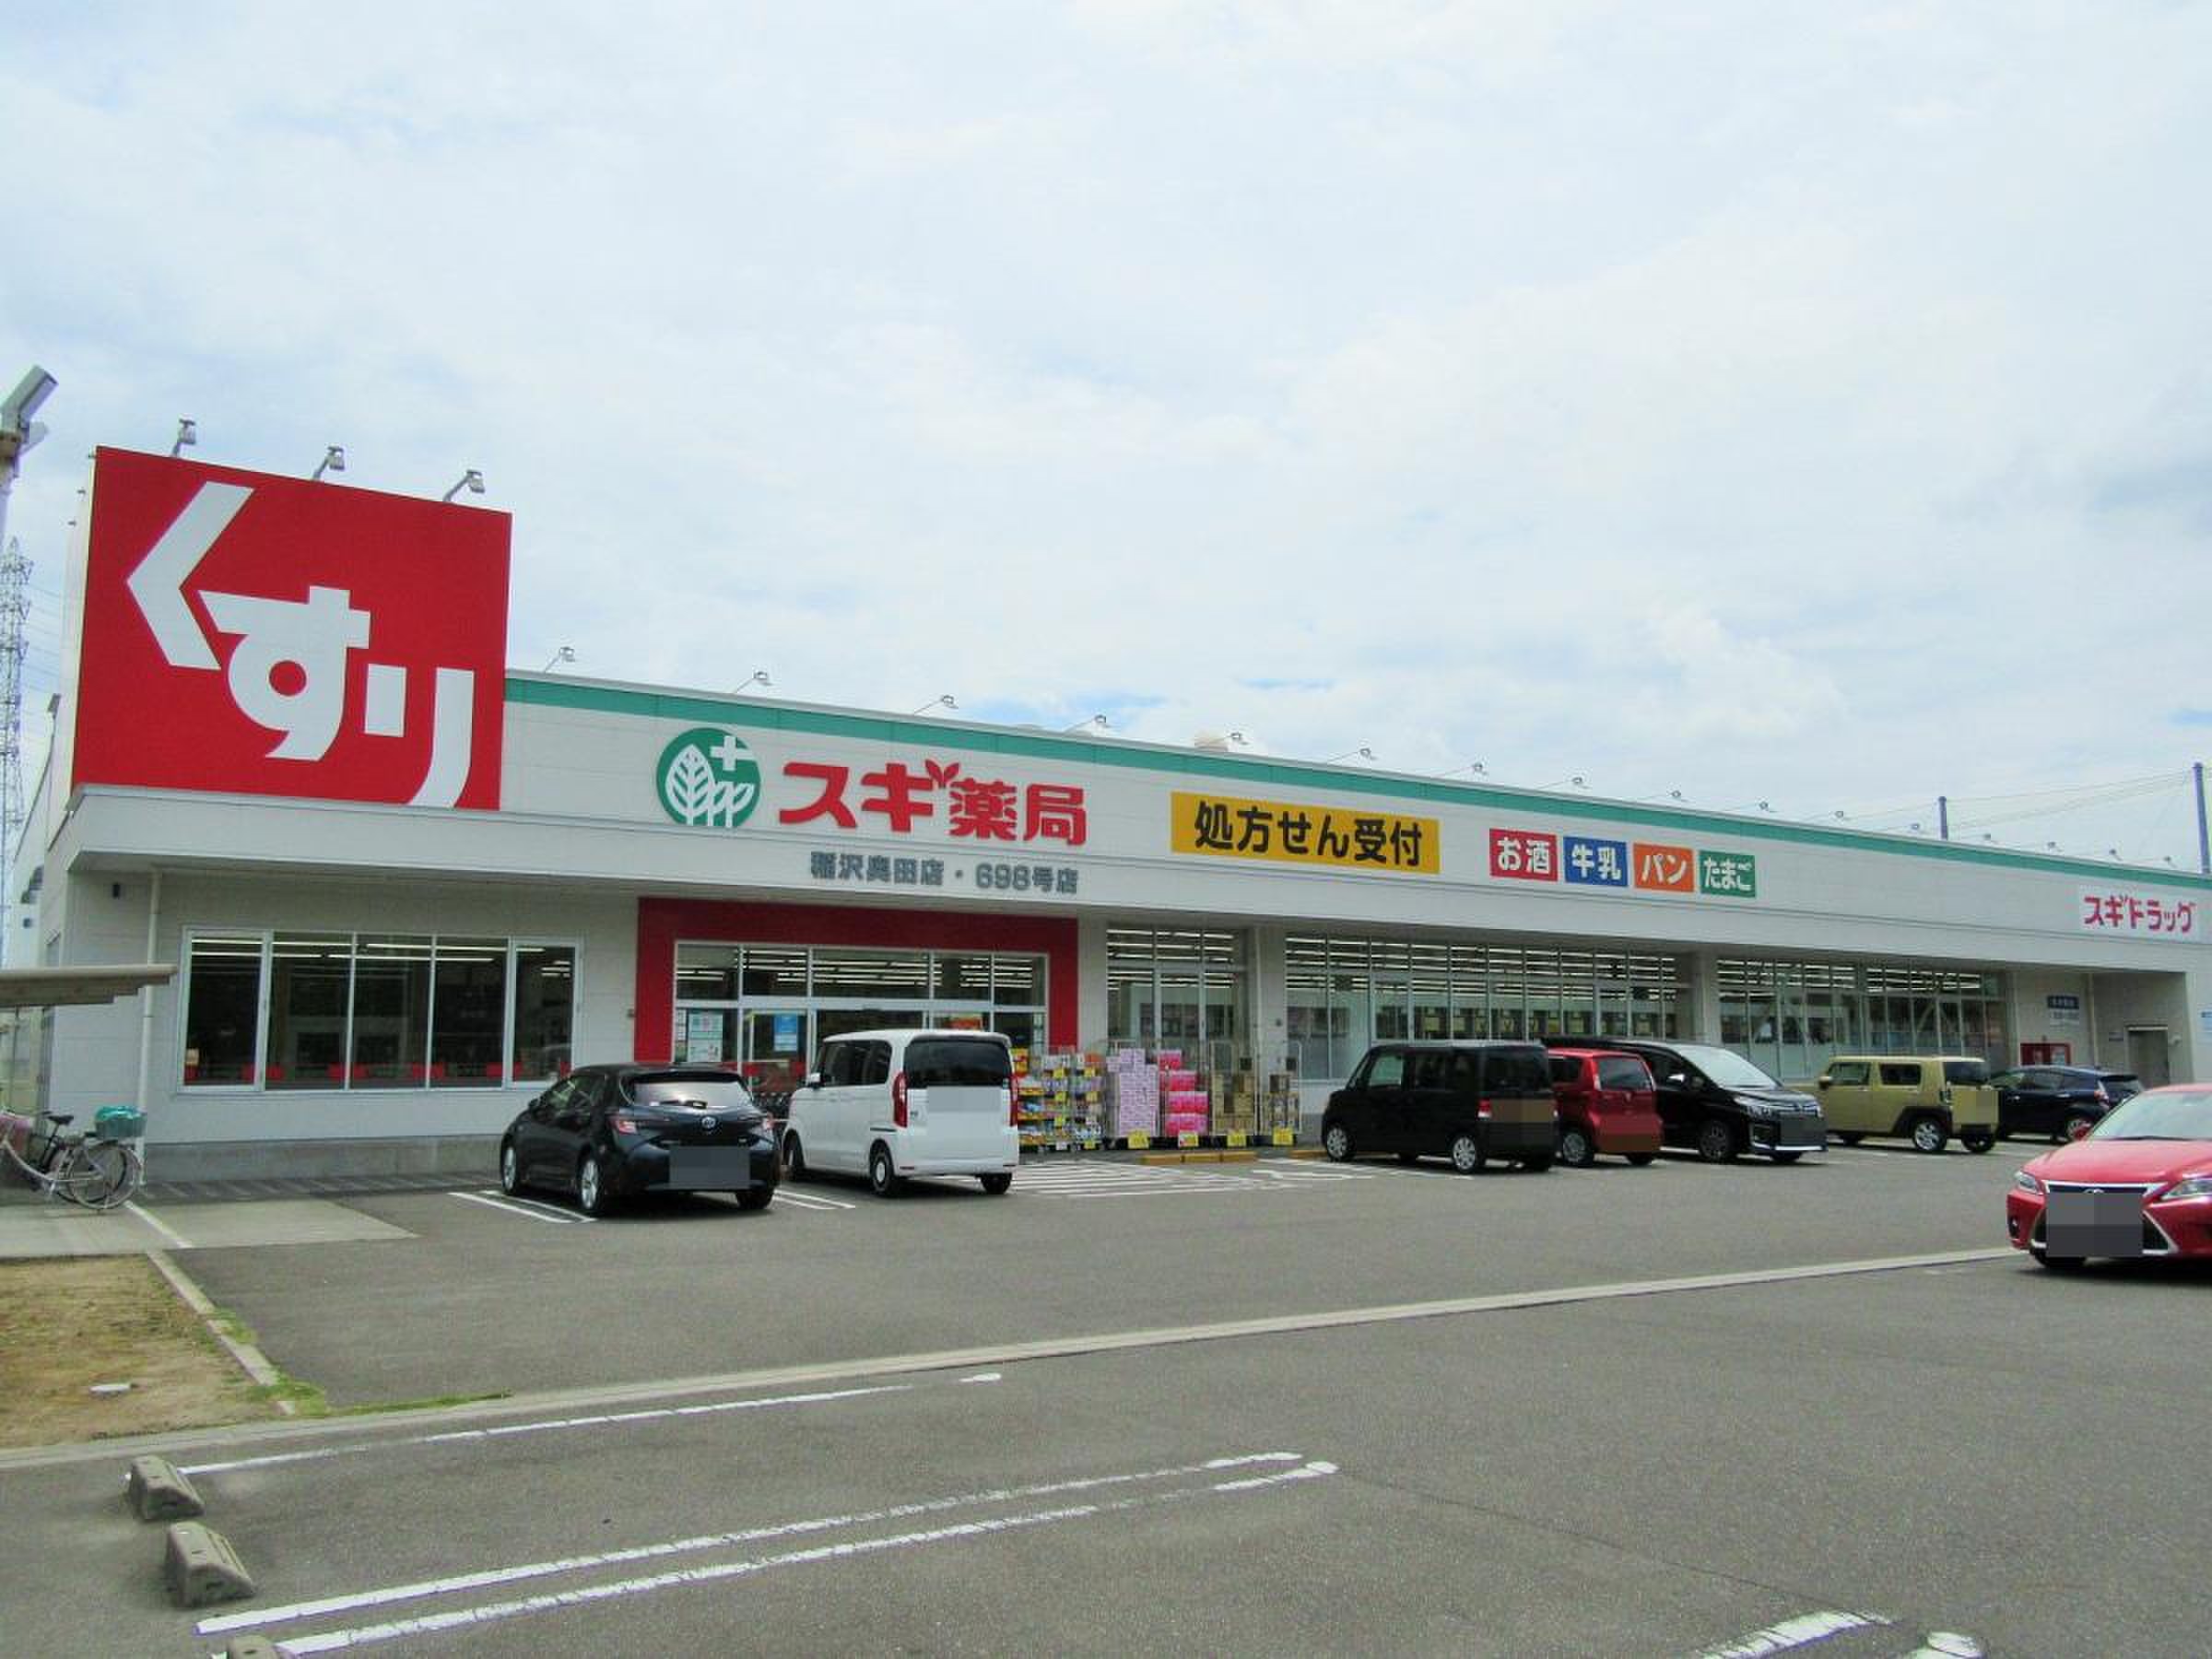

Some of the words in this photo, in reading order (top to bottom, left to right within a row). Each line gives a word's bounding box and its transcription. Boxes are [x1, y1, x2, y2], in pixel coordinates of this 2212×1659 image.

[127, 481, 474, 807] くすり
[779, 759, 1087, 845] スギ薬局
[1194, 801, 1423, 866] 処方せん受付
[1497, 835, 1550, 875] お酒
[1571, 843, 1622, 881] 牛乳
[1641, 853, 1688, 886] パン
[1703, 856, 1752, 890] たまご
[2084, 895, 2195, 933] スギドラッグ
